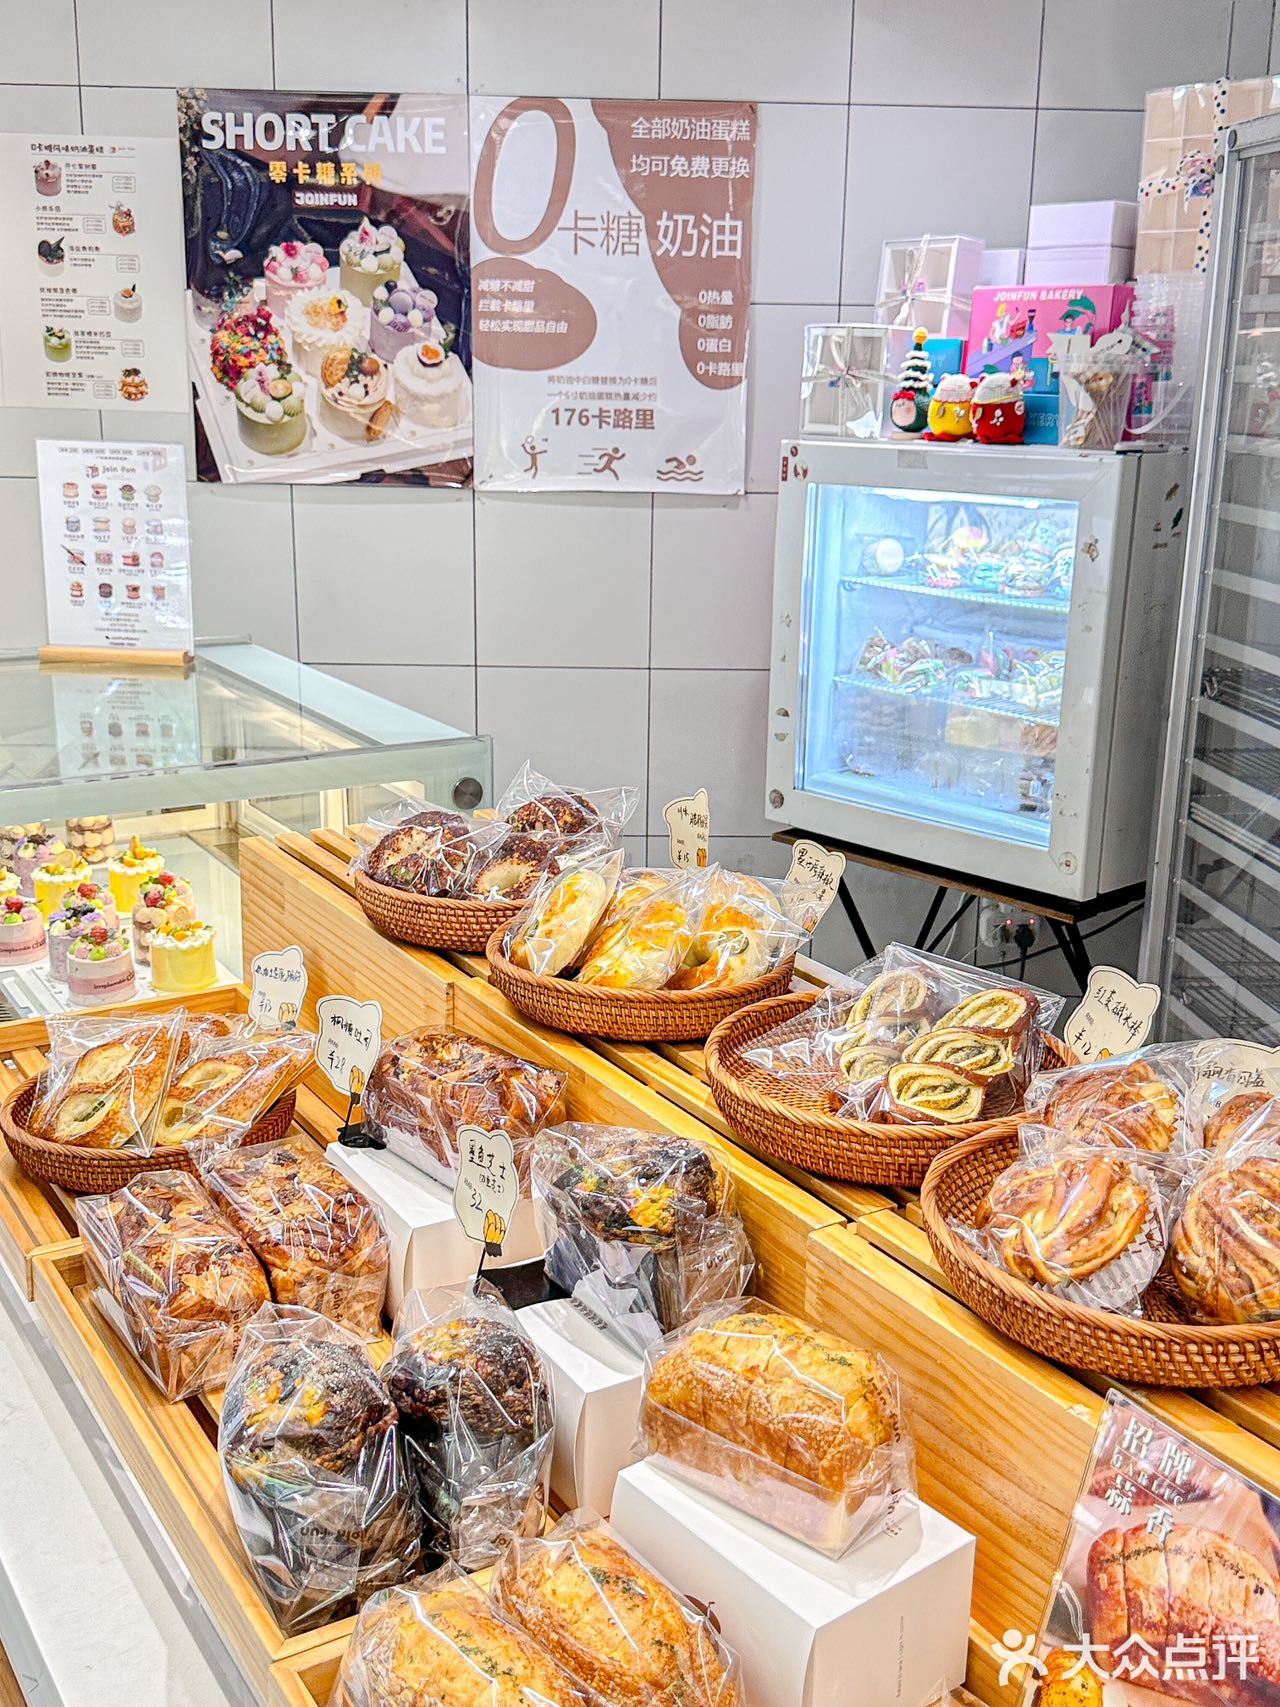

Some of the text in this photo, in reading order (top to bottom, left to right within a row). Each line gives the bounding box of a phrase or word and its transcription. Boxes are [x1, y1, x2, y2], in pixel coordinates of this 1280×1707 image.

[201, 111, 447, 155] SHORT CAKE
[630, 116, 751, 141] 全部奶油蛋糕
[630, 155, 751, 179] 均可免费更换
[294, 191, 358, 207] JOINFUN
[698, 289, 735, 306] 0热量
[993, 288, 1085, 302] JOINFUN BAKERY
[697, 313, 734, 330] 0脂肪
[696, 337, 732, 353] 0蛋白
[696, 360, 744, 377] 0卡路里
[550, 406, 656, 431] 176卡路里
